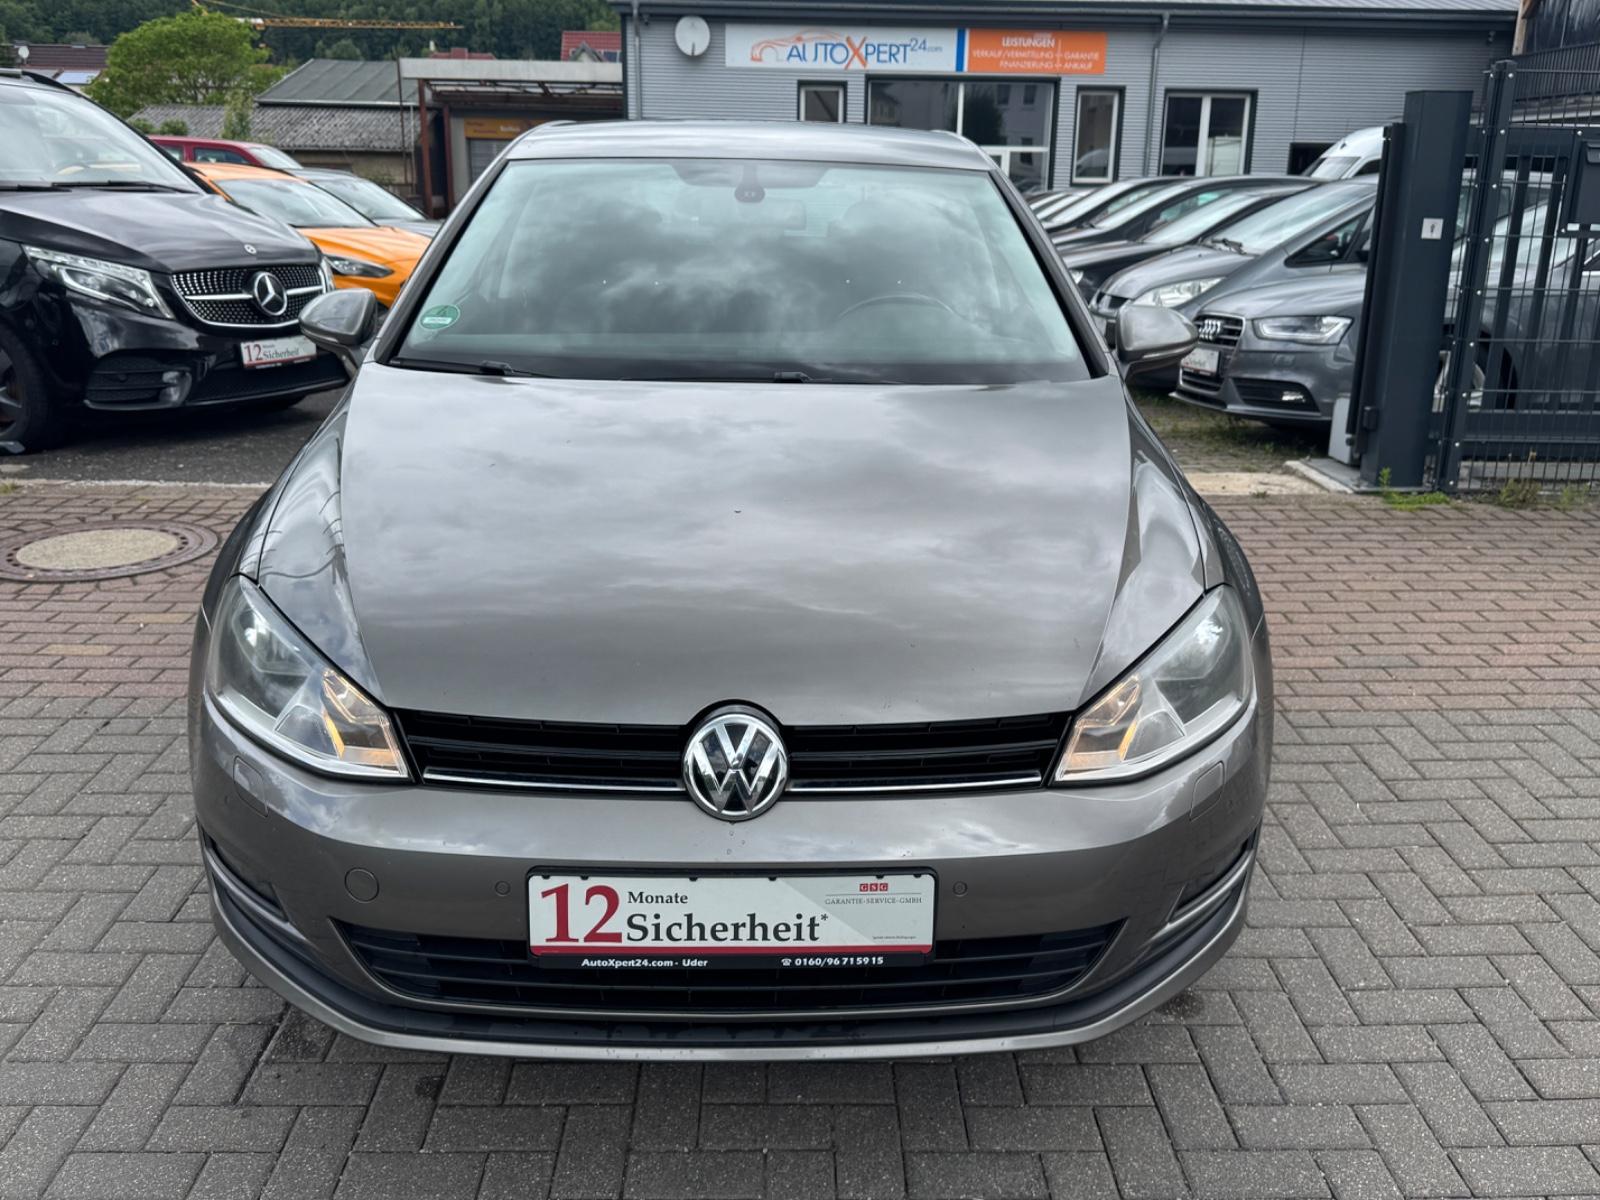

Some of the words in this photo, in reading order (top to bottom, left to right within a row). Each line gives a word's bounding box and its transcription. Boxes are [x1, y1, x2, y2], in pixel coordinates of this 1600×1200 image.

[1002, 36, 1055, 48] LEISTUNGEN
[244, 343, 263, 362] 12
[541, 882, 623, 944] 12
[627, 890, 688, 904] Monate
[581, 958, 674, 969] AutoXpert24.com
[682, 958, 708, 968] Uder
